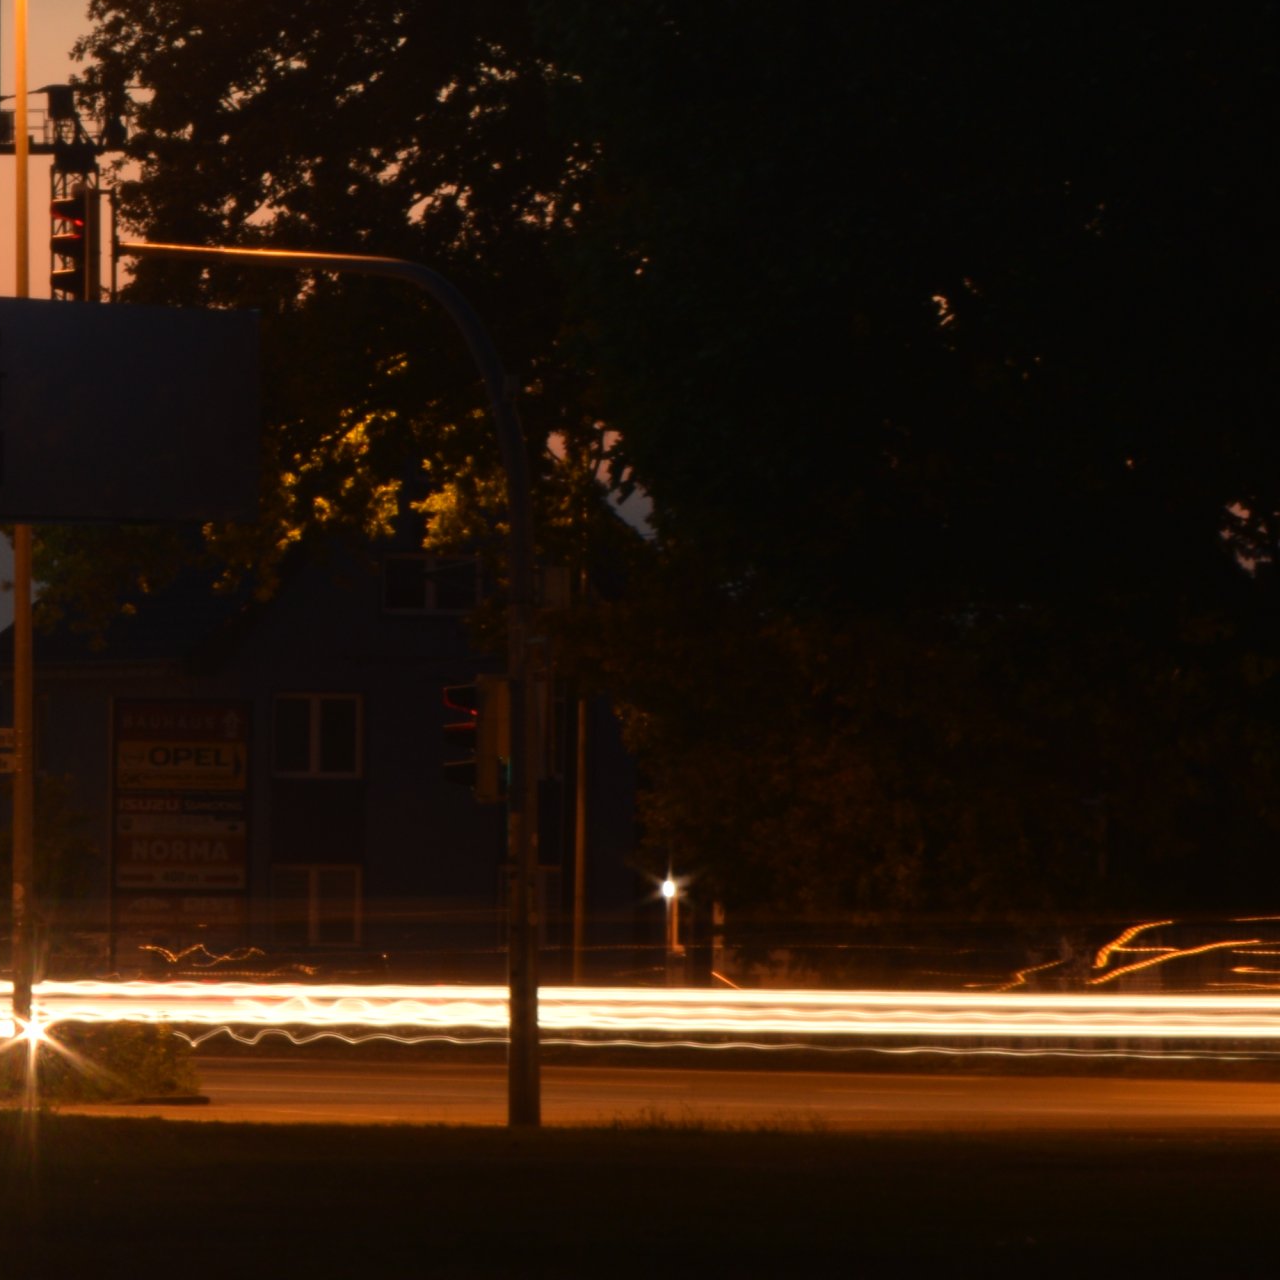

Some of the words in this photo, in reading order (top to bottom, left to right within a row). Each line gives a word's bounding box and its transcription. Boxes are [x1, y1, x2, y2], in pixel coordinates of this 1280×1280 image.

[148, 746, 230, 767] OPEL
[119, 798, 179, 810] ISUZU
[130, 839, 229, 861] NORMA
